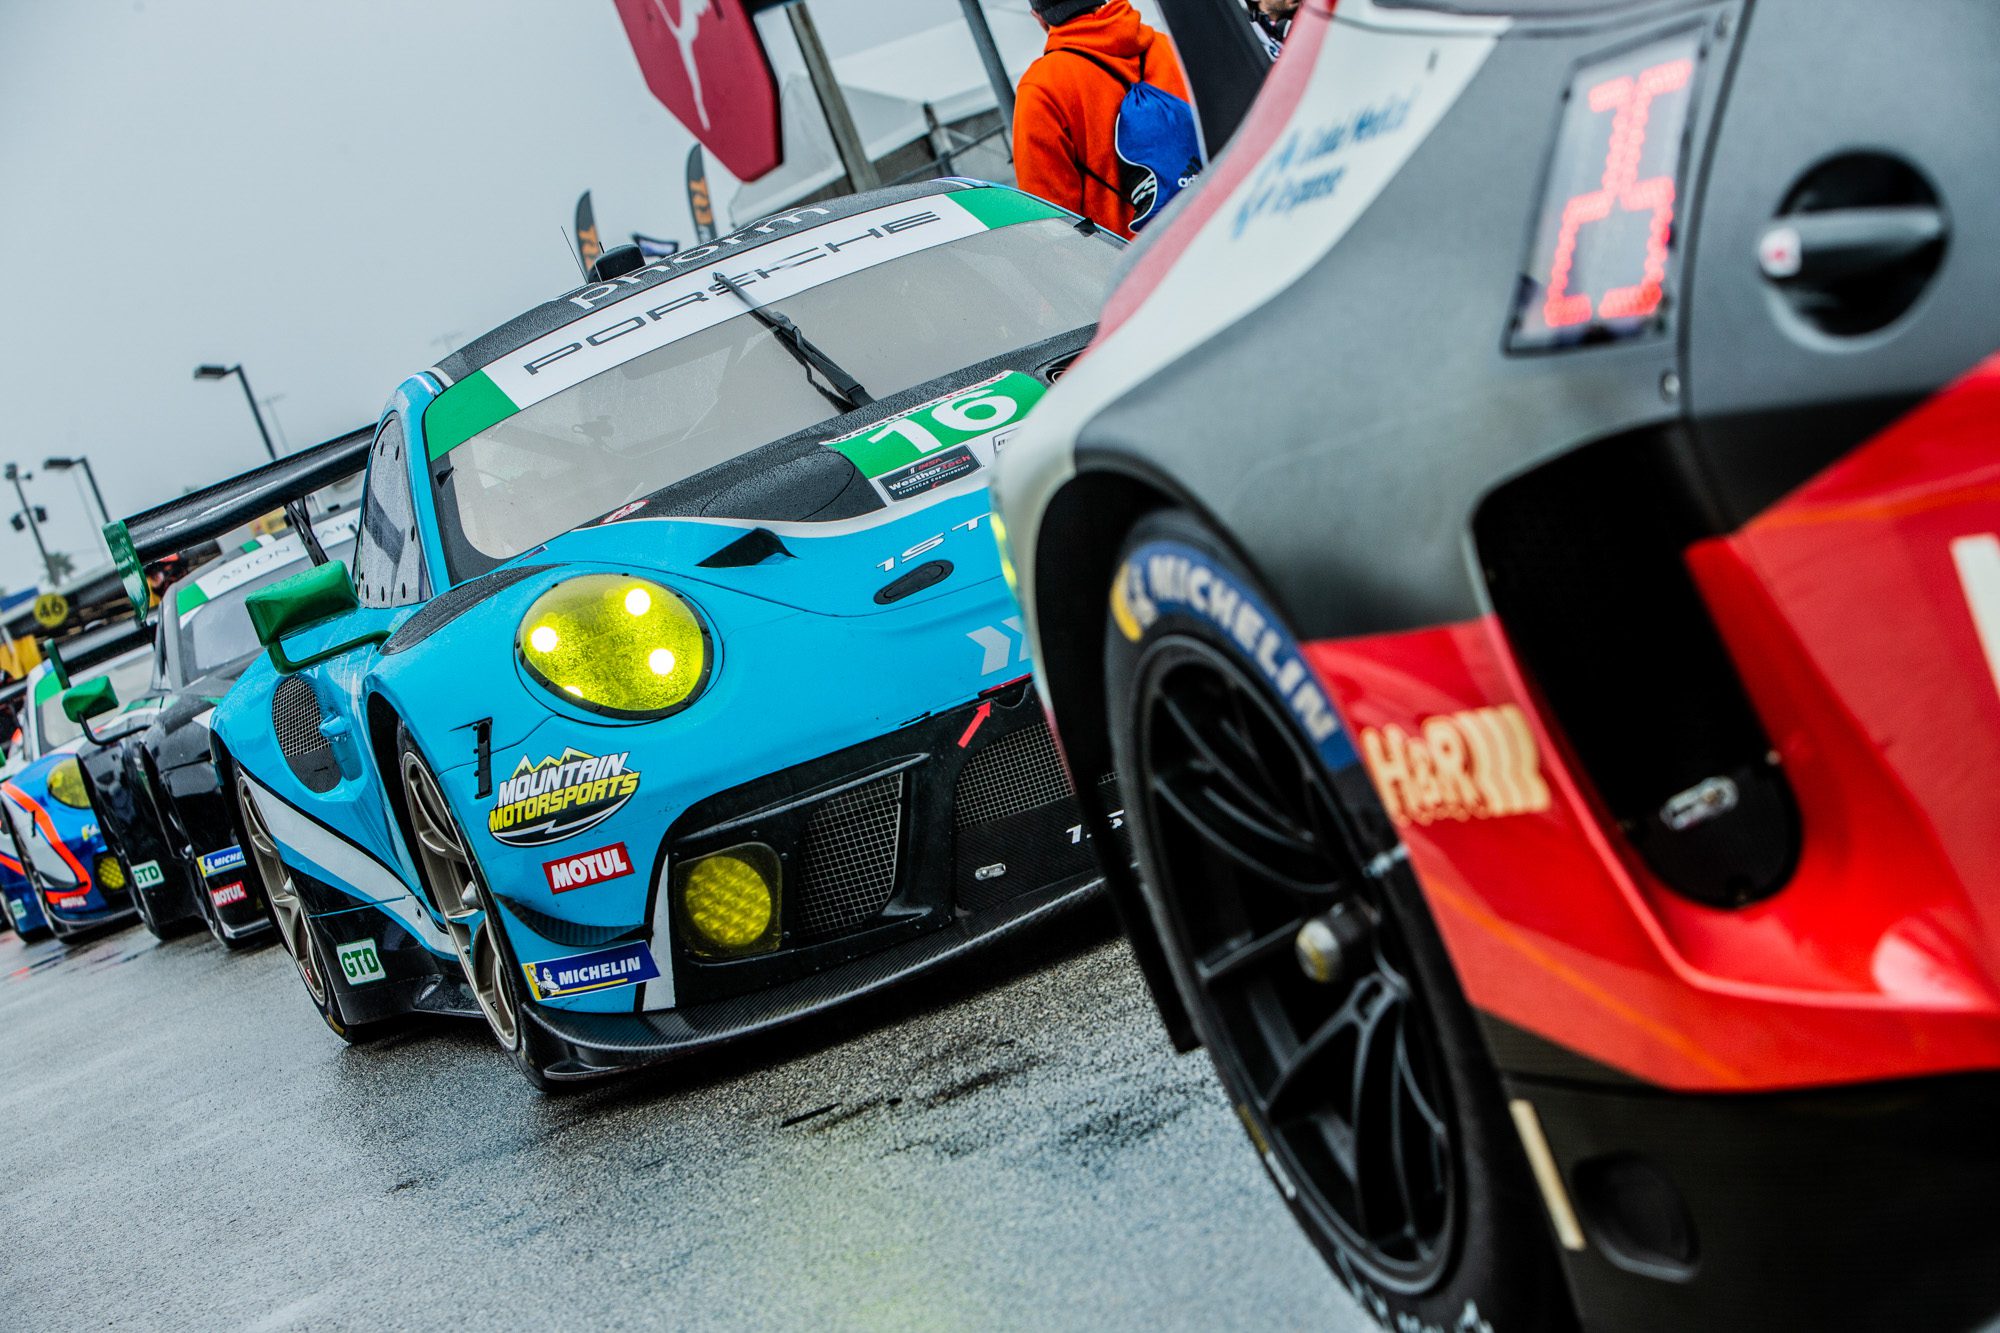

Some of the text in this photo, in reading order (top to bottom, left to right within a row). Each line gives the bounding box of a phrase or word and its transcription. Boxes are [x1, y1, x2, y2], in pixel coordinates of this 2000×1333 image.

[523, 210, 942, 376] PORSCHE
[867, 389, 1018, 454] 16
[876, 511, 993, 573] 1ST
[40, 597, 64, 617] 46
[1149, 553, 1338, 743] MICHELIN
[489, 771, 641, 833] MOTORSPORTS
[498, 751, 630, 808] MOUNTAIN
[212, 883, 245, 907] MOTUL
[550, 848, 628, 890] MOTUL
[341, 947, 380, 978] GTD
[558, 956, 641, 986] MICHELIN
